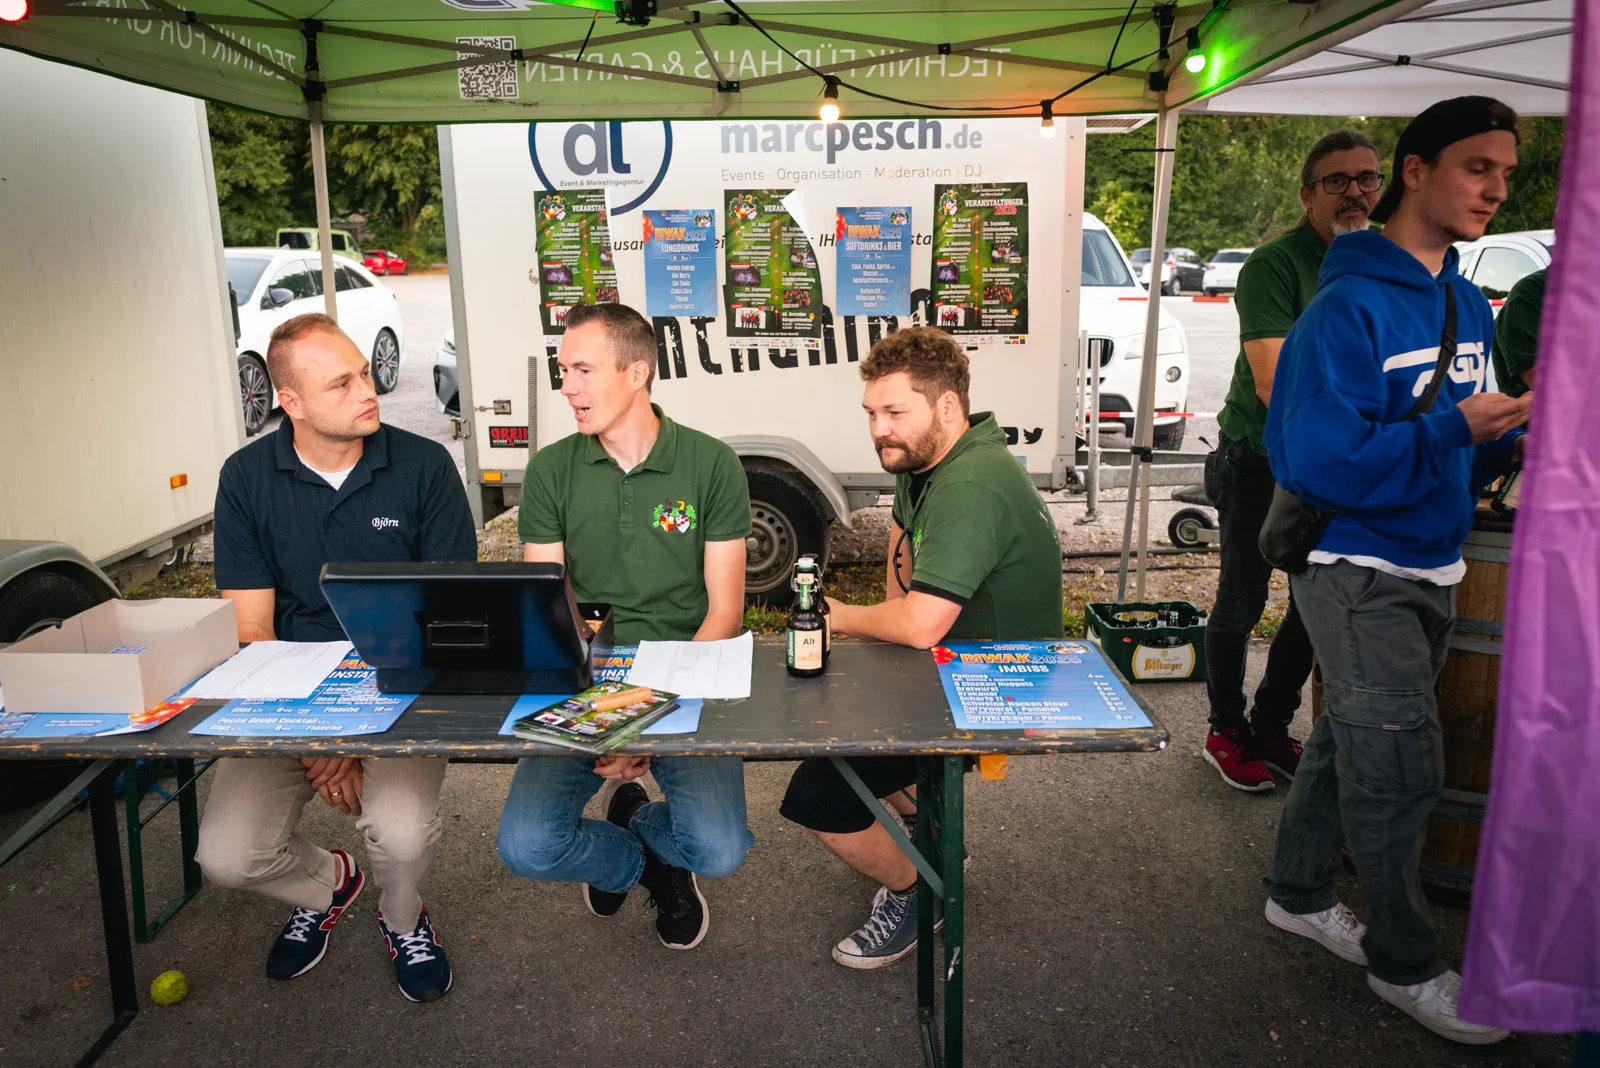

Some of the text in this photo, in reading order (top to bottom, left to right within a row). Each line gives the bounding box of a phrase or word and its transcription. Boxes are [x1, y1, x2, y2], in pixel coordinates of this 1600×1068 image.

[721, 118, 982, 165] marcpesch.de
[721, 164, 982, 184] Events Organisation Moderation DJ
[586, 178, 645, 188] Marketingagentur
[964, 198, 1024, 207] VERANSTALTUNGEN
[661, 243, 699, 252] LONGDRINKS
[845, 241, 884, 251] SOFTDRINKS
[887, 241, 902, 250] BIER
[371, 517, 399, 530] Björn
[998, 665, 1050, 673] IMBISS
[1144, 658, 1183, 671] Bitburger
